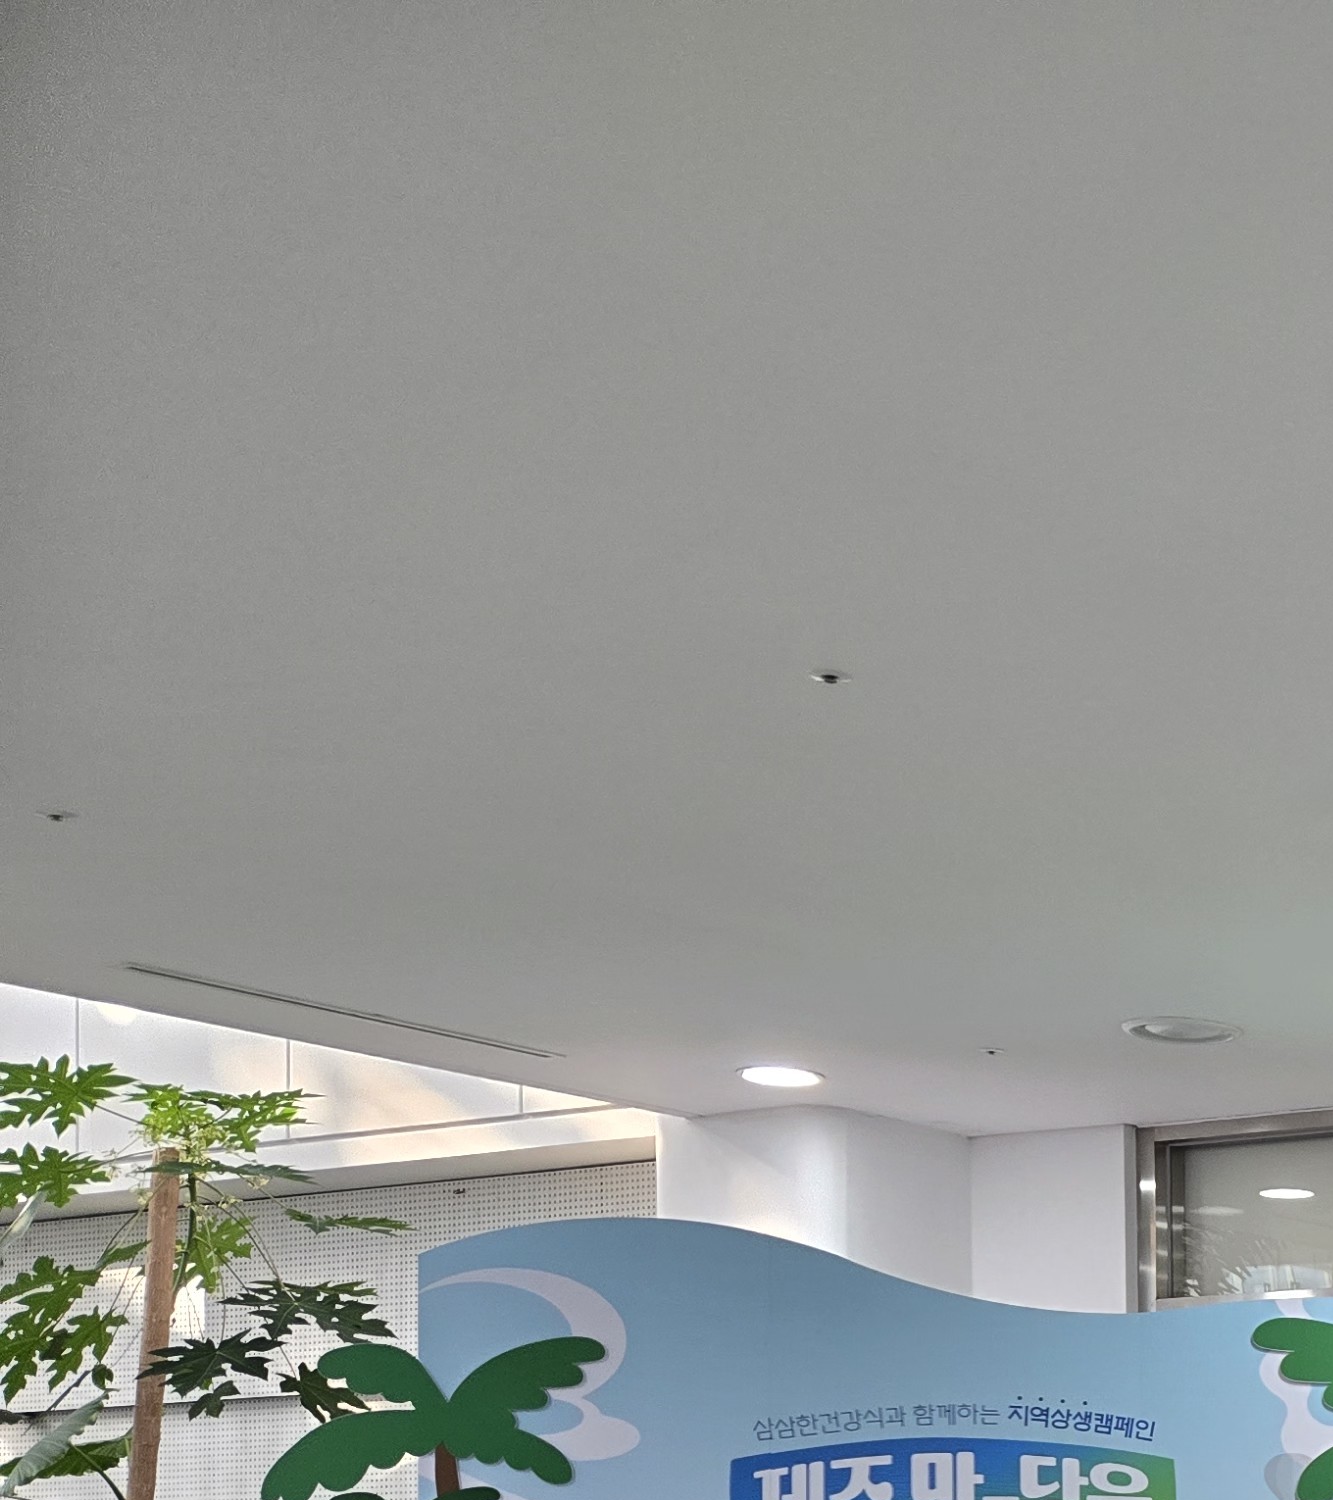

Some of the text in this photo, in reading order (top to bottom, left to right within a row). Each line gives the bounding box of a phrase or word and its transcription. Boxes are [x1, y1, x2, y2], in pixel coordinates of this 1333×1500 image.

[753, 1403, 1157, 1442] 삼삼한건강식과 함께하는 지역상생캠페인
